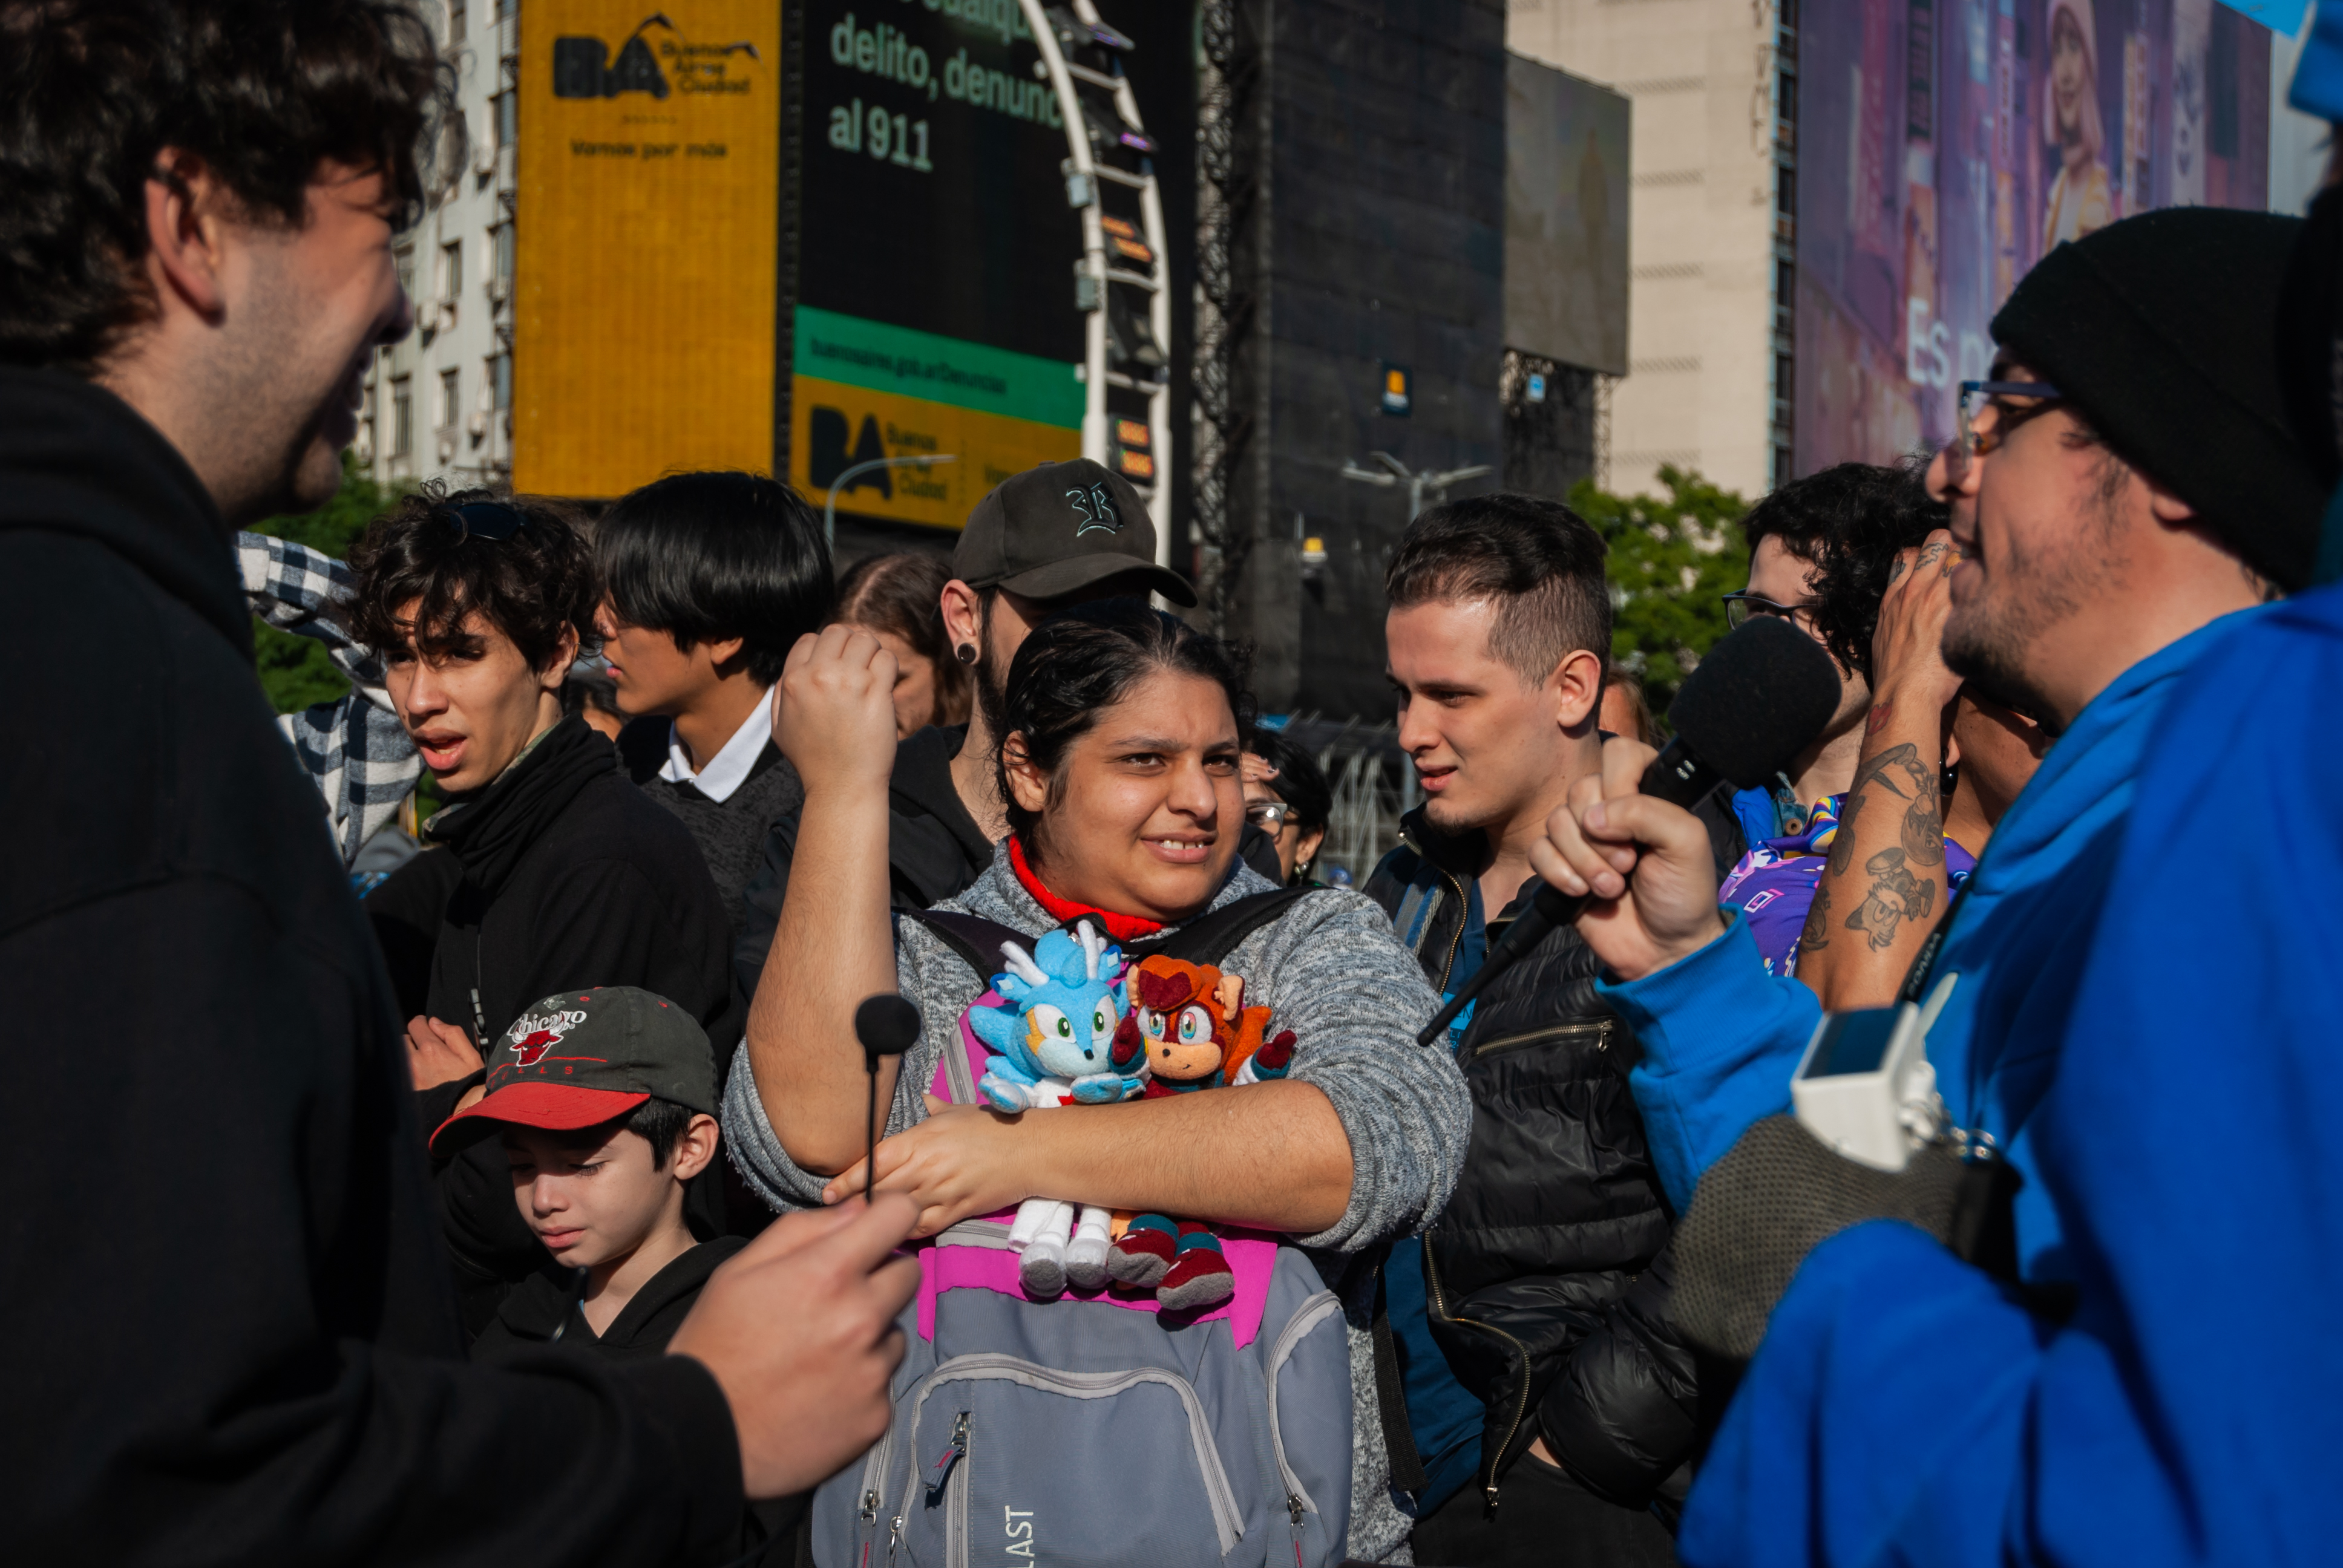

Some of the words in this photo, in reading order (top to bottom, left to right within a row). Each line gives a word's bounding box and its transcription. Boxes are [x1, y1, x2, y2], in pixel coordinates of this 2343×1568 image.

[830, 12, 939, 102] delito,
[944, 47, 1068, 129] denunc
[640, 142, 679, 163] por
[828, 97, 862, 154] al
[867, 105, 934, 173] 911
[1907, 296, 1951, 390] Es
[810, 404, 893, 501] BA
[506, 1010, 588, 1036] Chicago
